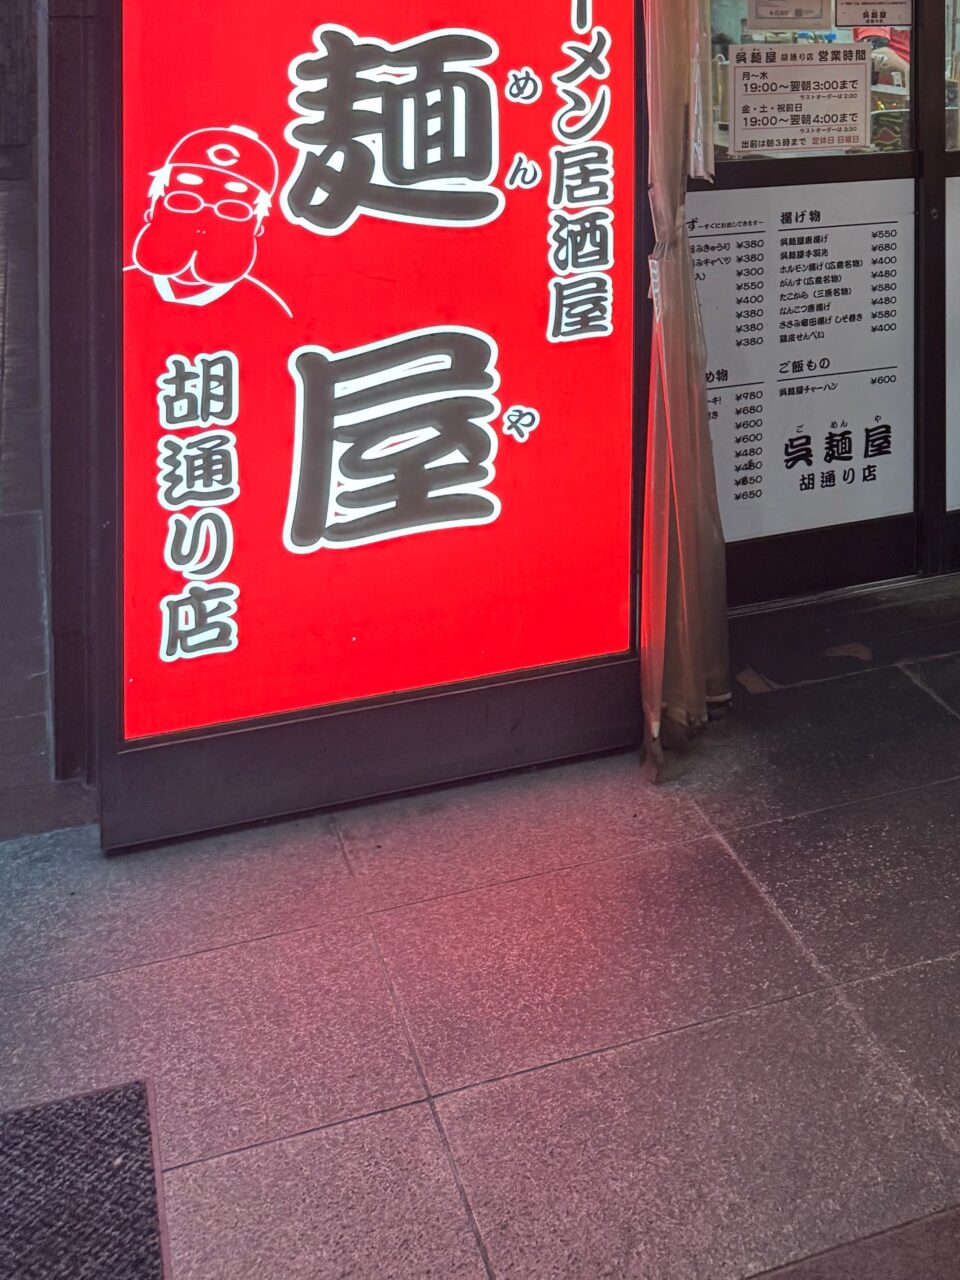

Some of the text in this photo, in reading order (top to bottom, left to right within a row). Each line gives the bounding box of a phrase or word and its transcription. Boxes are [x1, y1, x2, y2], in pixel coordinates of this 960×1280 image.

[818, 49, 866, 61] 営業時間
[780, 209, 821, 225] 揚げ物
[871, 229, 897, 239] ¥550
[736, 239, 764, 249] ¥380
[871, 242, 897, 252] ¥680
[736, 253, 764, 263] ¥380
[871, 256, 897, 266] ¥400
[736, 267, 764, 277] ¥300
[871, 269, 897, 279] ¥480
[735, 281, 764, 291] ¥550
[871, 282, 897, 292] ¥580
[735, 295, 764, 305] ¥400
[871, 296, 897, 306] ¥480
[735, 308, 764, 319] ¥380
[871, 309, 897, 319] ¥580
[735, 322, 764, 333] ¥380
[871, 323, 897, 333] ¥400
[735, 336, 763, 347] ¥380
[870, 374, 897, 386] ¥600
[735, 390, 763, 401] ¥980
[735, 404, 763, 415] ¥680
[502, 405, 540, 442] や
[735, 418, 763, 429] ¥600
[735, 433, 763, 444] ¥600
[783, 423, 893, 470] 呉麺屋
[735, 447, 763, 458] ¥480
[799, 464, 878, 492] 胡通り店
[734, 489, 763, 500] ¥650
[157, 350, 240, 663] 胡通り店
